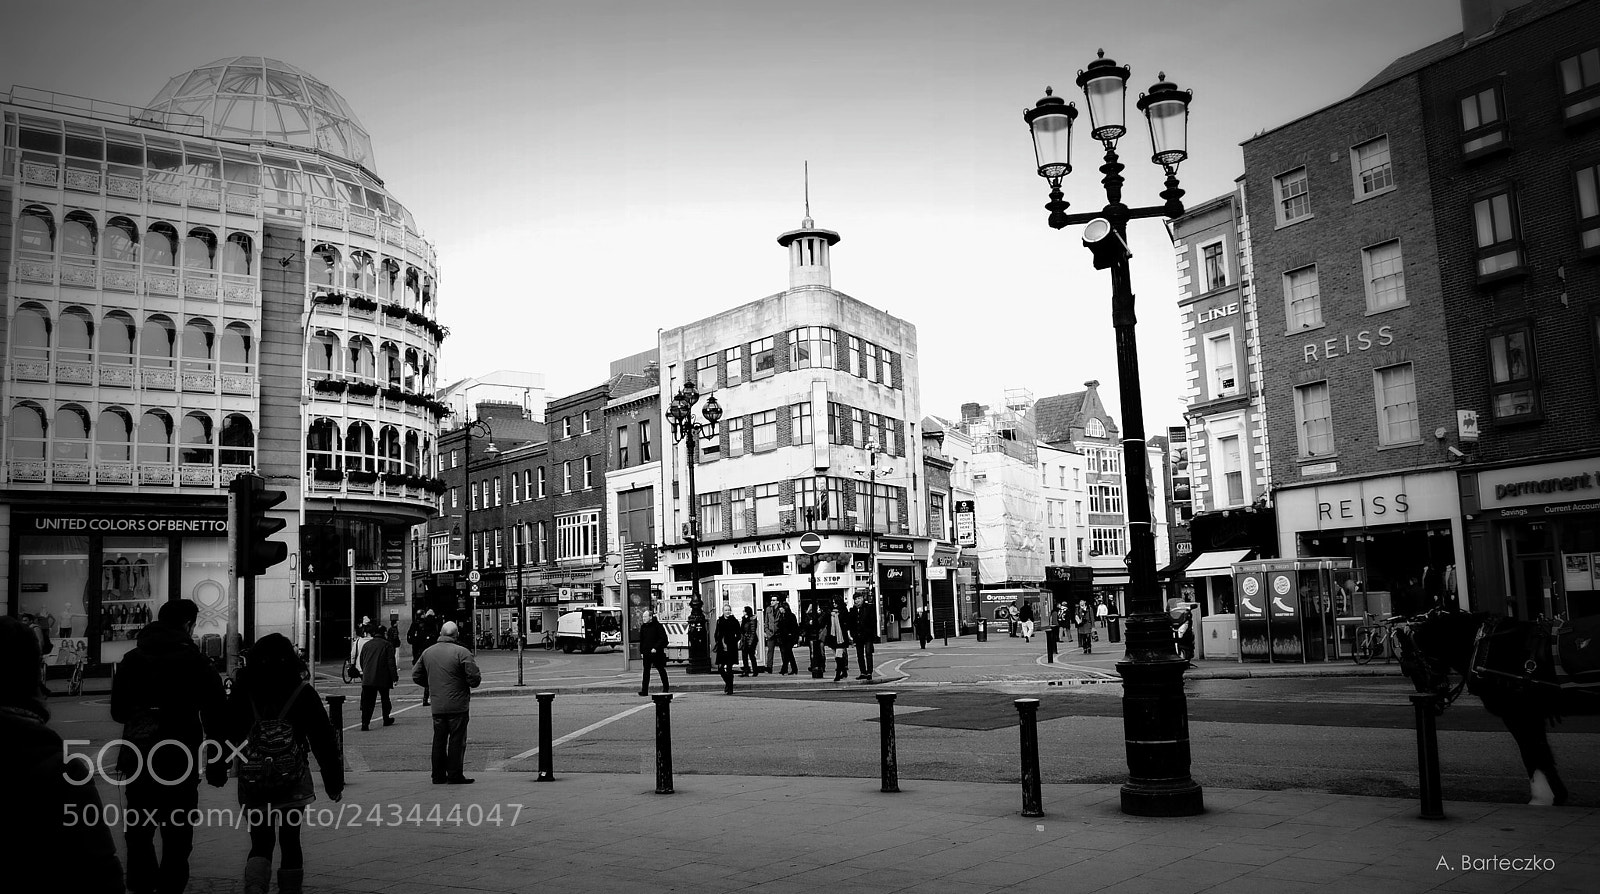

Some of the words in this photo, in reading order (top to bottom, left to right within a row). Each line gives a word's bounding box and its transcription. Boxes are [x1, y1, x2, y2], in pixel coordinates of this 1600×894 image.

[1198, 302, 1239, 324] LINE
[1303, 325, 1394, 364] REISS
[1495, 472, 1592, 500] permanent
[1319, 493, 1409, 521] REISS
[1501, 508, 1528, 517] Savings
[1544, 504, 1571, 514] Current
[35, 518, 87, 530] UNITED
[89, 519, 145, 531] COLORS
[147, 519, 166, 531] OF
[677, 551, 690, 560] BUS
